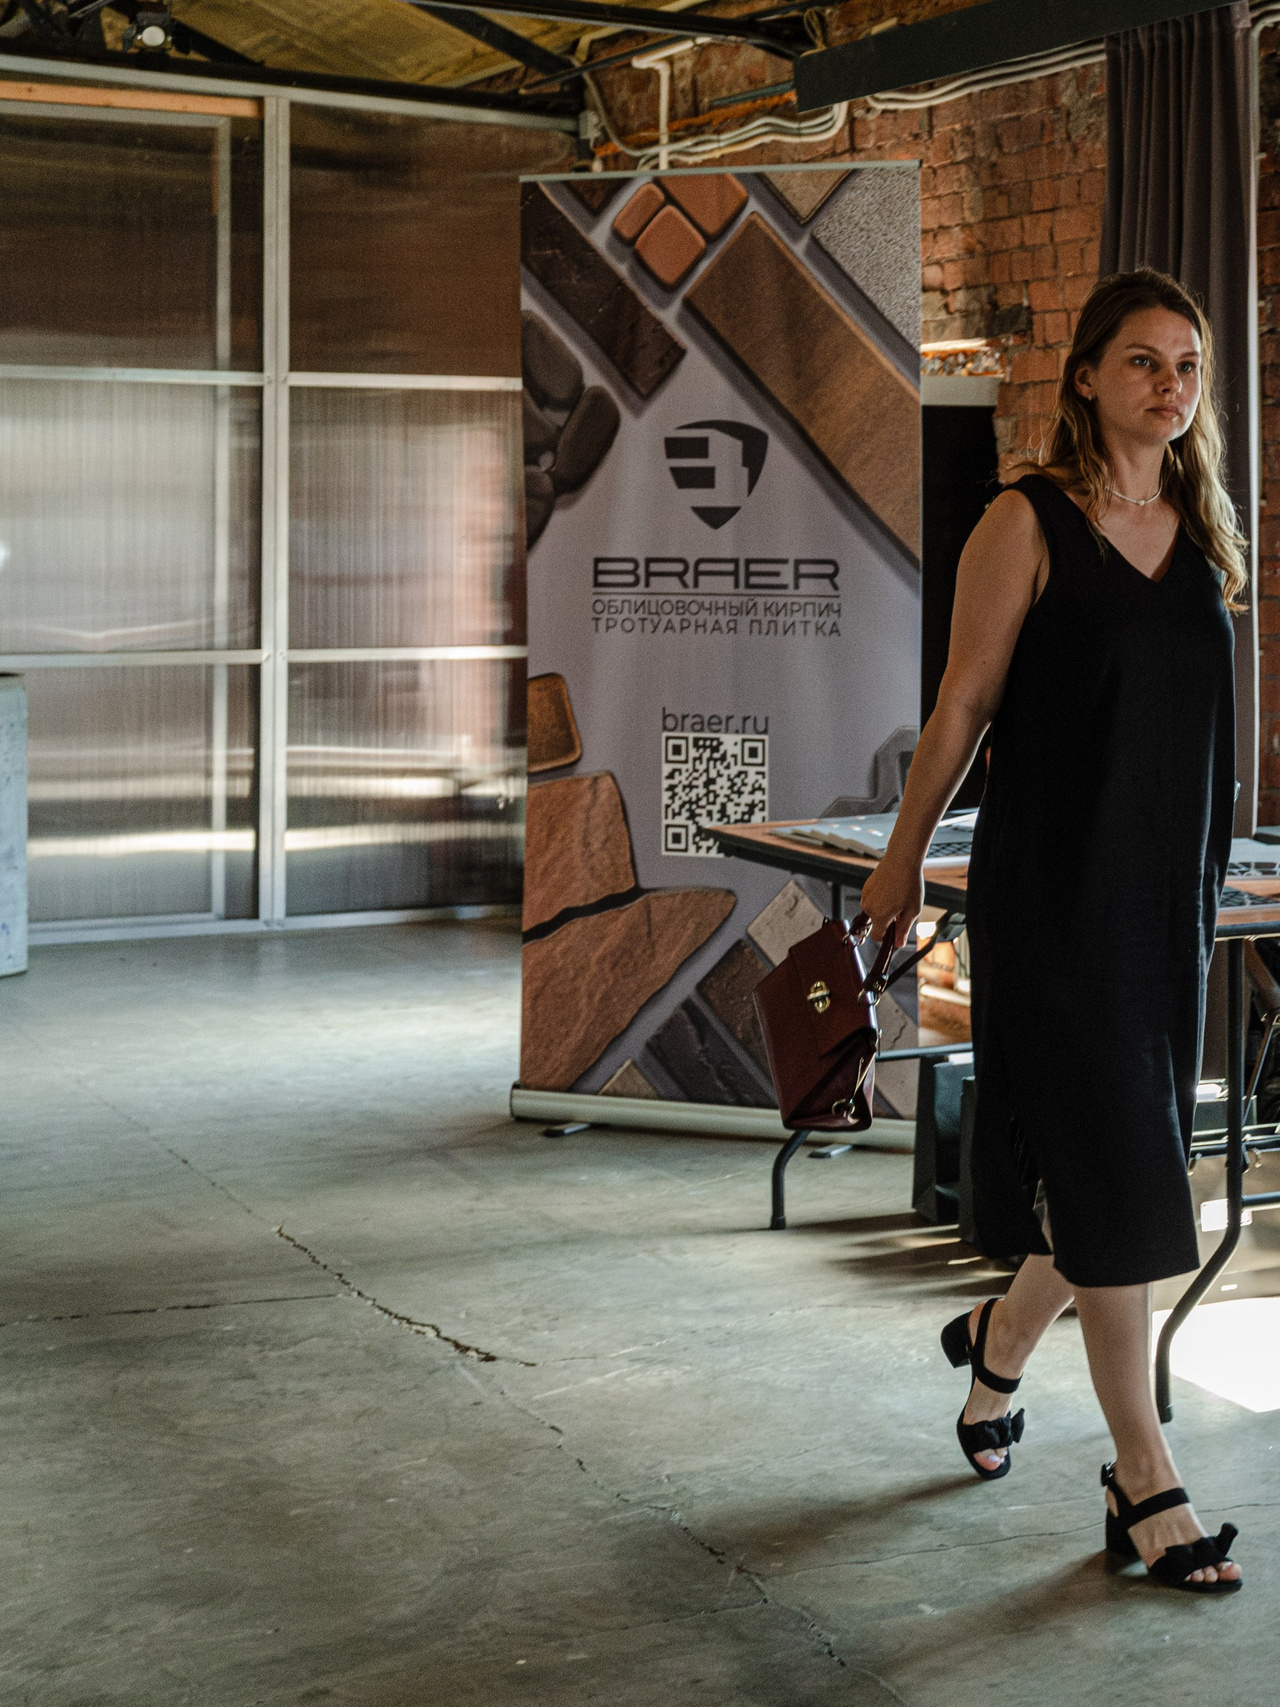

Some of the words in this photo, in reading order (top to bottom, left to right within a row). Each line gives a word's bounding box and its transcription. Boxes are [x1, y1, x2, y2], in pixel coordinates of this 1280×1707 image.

[593, 557, 840, 591] BRAER
[592, 598, 758, 618] ОБЛИЦОВОЧНЫЙ
[763, 602, 841, 619] КИРПИЧ
[592, 617, 738, 635] ТРОТУАРНАЯ
[748, 620, 841, 637] ПЛИТКА
[662, 706, 769, 735] braer.ru
